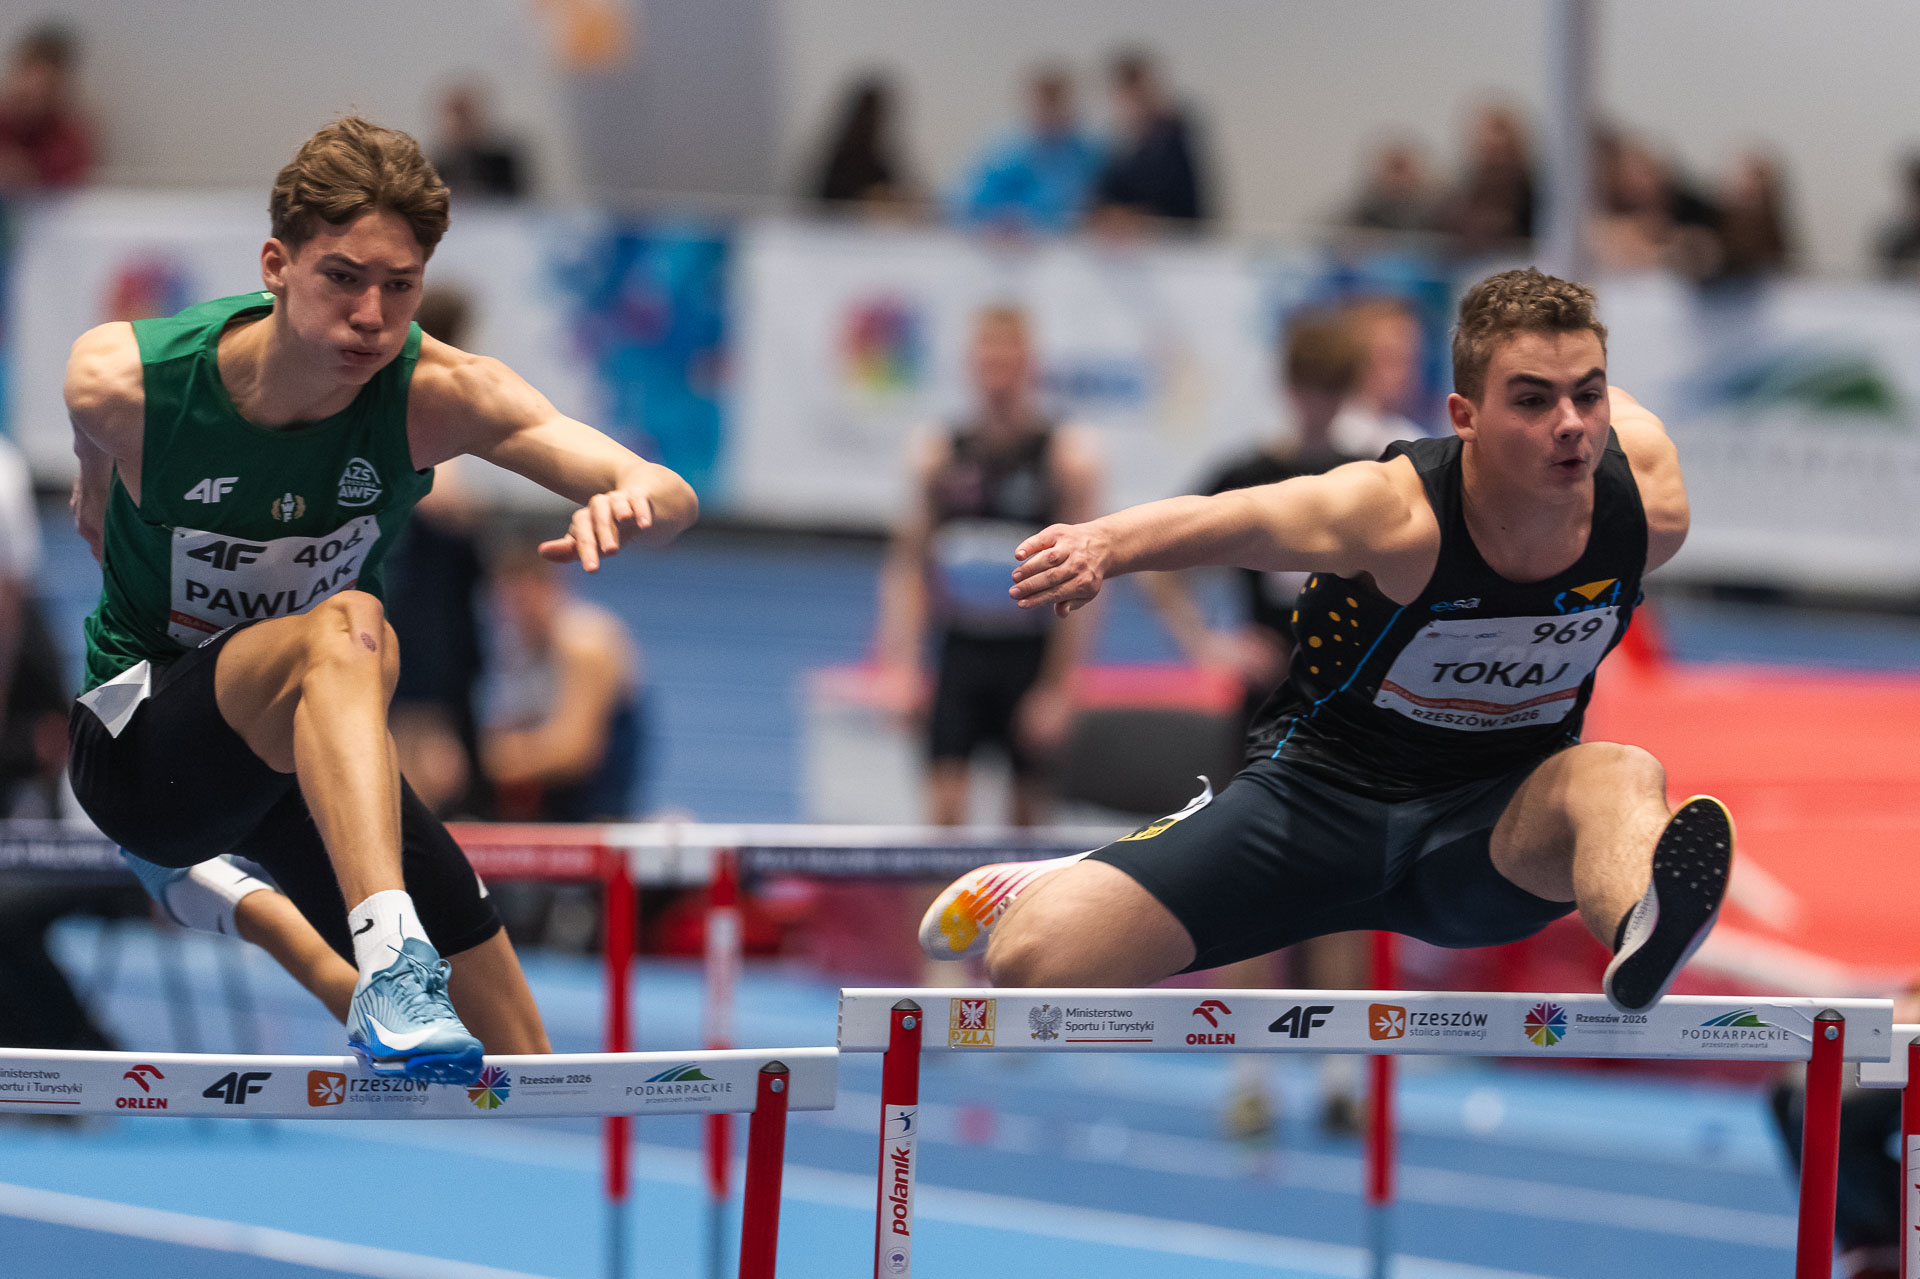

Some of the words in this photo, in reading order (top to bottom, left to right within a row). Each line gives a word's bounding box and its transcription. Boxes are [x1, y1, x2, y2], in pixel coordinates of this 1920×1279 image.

[338, 466, 371, 482] AZS
[184, 477, 239, 503] 4F
[338, 485, 374, 499] AWF
[187, 540, 268, 571] 4F
[186, 555, 357, 619] PAWLAK
[1430, 597, 1481, 612] esa
[1531, 617, 1603, 644] 969
[1432, 661, 1571, 688] TOKAJ
[1411, 708, 1499, 728] RZESZÓW
[1501, 709, 1540, 726] 2026
[1065, 1008, 1133, 1018] Ministerstwo
[1410, 1009, 1488, 1027] rzeszów
[1576, 1013, 1619, 1024] Rzeszów
[1622, 1014, 1648, 1024] 2026
[1065, 1021, 1100, 1033] Sportu
[1109, 1021, 1155, 1033] Turystyki
[1268, 1005, 1334, 1038] 4F
[1186, 1033, 1235, 1045] ORLEN
[1409, 1027, 1440, 1037] stolica
[1443, 1028, 1487, 1040] innowacji
[1682, 1029, 1789, 1041] PODKARPACKIE
[0, 1068, 60, 1079] inisterstwo
[519, 1075, 566, 1085] Rzeszów
[567, 1074, 592, 1084] 2026
[33, 1082, 83, 1094] Turystyki
[202, 1071, 272, 1105] 4F
[625, 1083, 733, 1096] PODKARPACKIE
[116, 1097, 168, 1109] ORLEN
[889, 1146, 911, 1237] polanik
